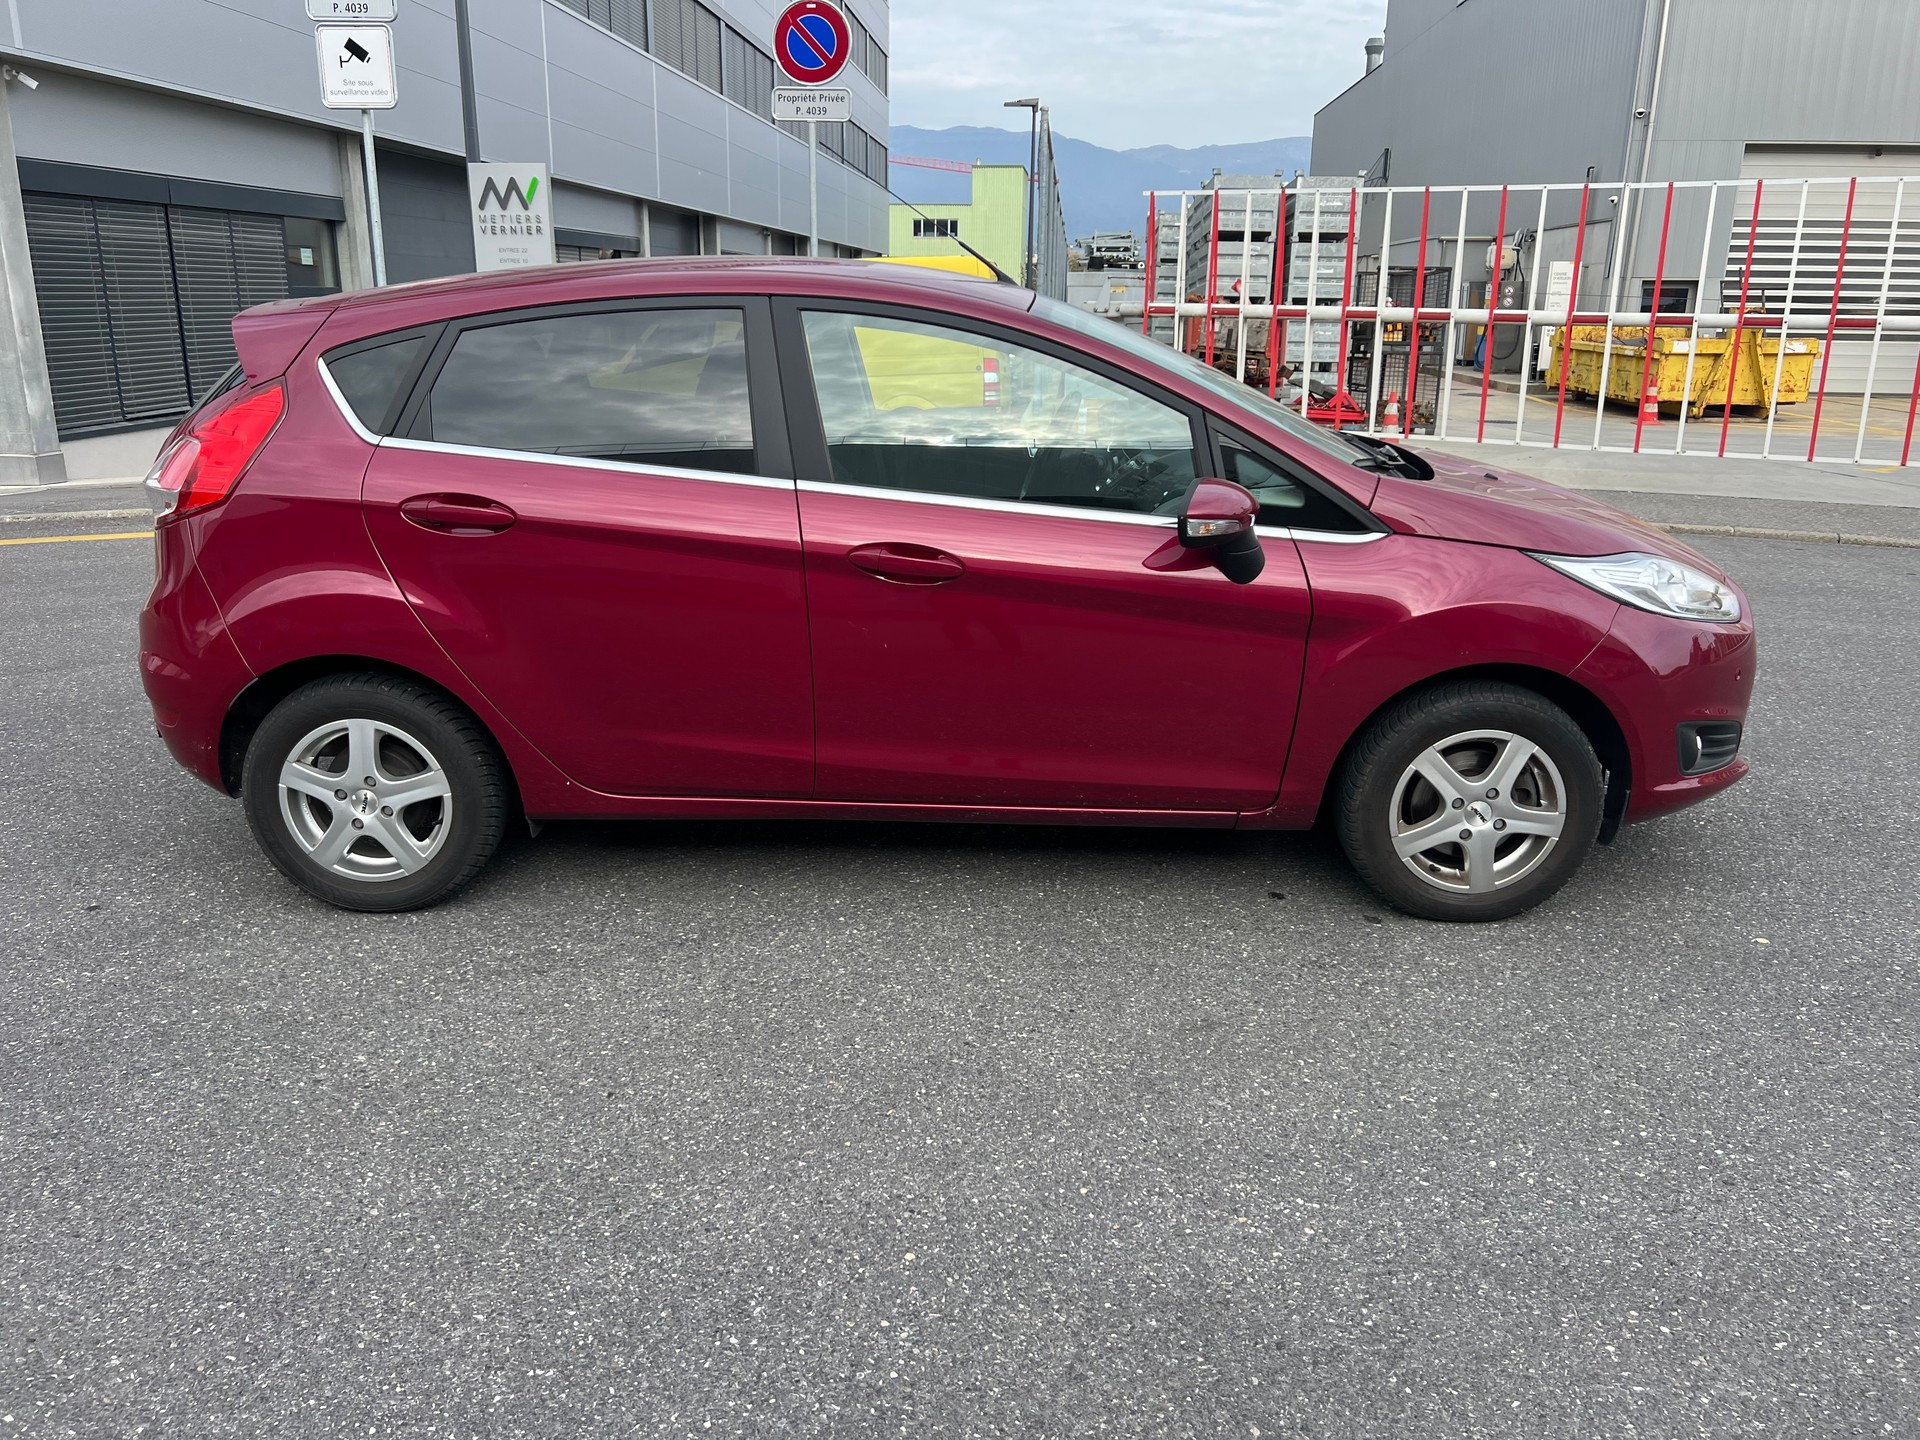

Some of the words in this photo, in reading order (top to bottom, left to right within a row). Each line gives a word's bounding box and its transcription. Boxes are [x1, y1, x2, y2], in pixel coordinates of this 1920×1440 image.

[333, 3, 342, 13] P.
[344, 3, 369, 13] 4039
[342, 79, 356, 87] Site
[329, 88, 369, 96] surveillance
[370, 88, 389, 96] vidéo
[777, 93, 817, 105] Propriété
[819, 93, 845, 103] Privée
[795, 106, 804, 116] P.
[806, 106, 828, 116] 4039
[478, 214, 543, 224] METIERS
[480, 225, 544, 235] VERNIER
